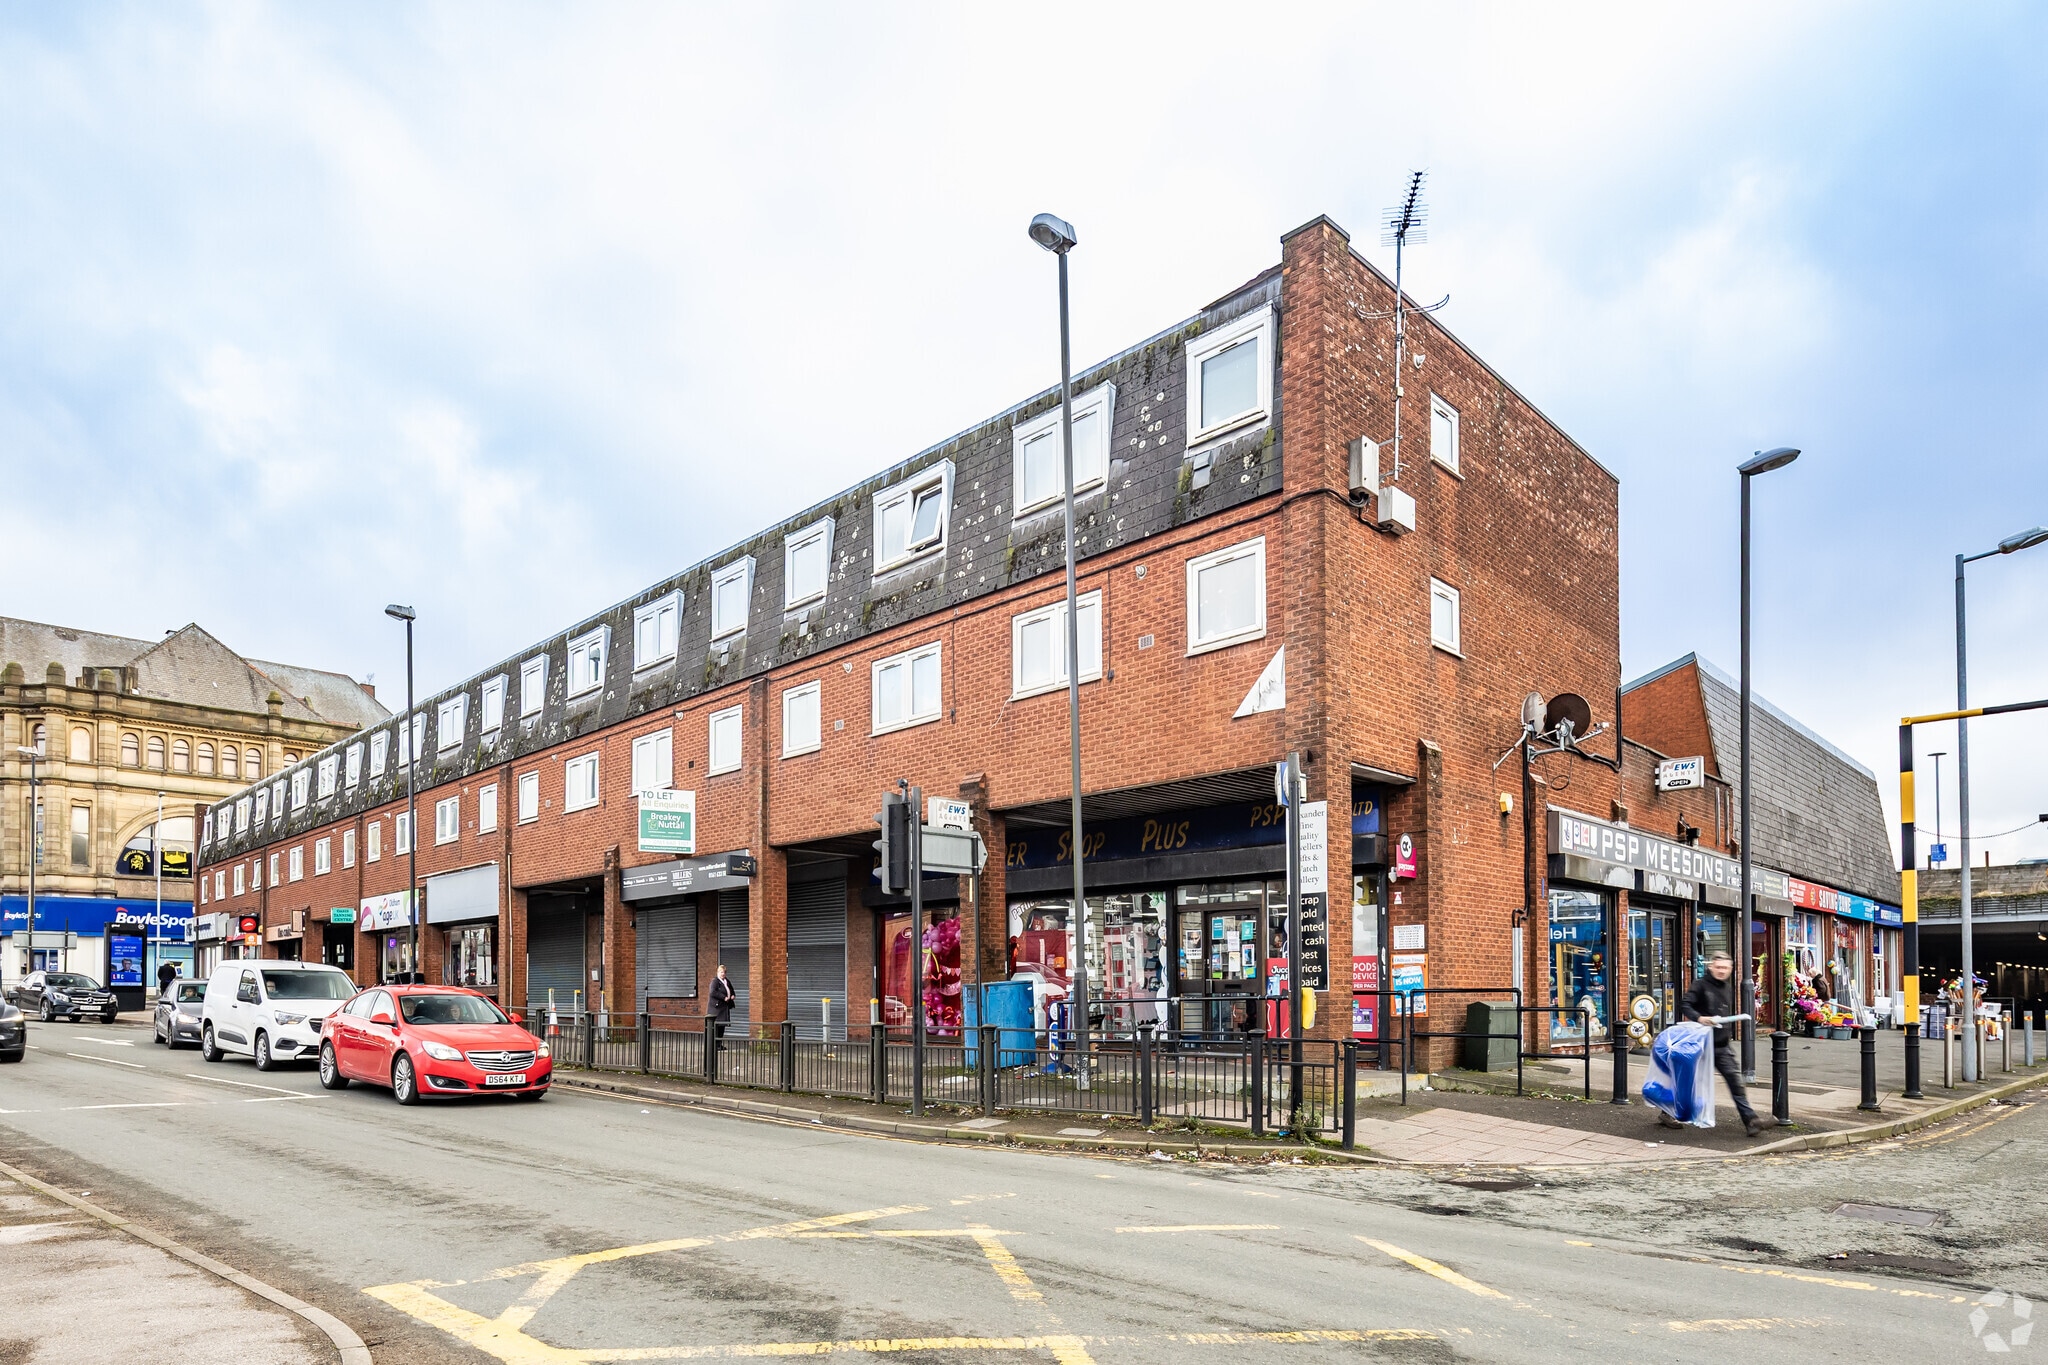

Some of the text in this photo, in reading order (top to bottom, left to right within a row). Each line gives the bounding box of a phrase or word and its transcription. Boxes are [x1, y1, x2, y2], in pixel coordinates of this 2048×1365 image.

[641, 790, 674, 800] TO LET
[653, 800, 690, 809] Enquiries
[651, 812, 682, 822] Breakey
[658, 820, 685, 829] Nuttall
[1141, 819, 1190, 852] PLUS
[1352, 800, 1374, 817] LTD
[1601, 828, 1639, 863] PSP
[1645, 839, 1723, 883] MEESONS
[1301, 865, 1318, 873] atch
[1397, 863, 1415, 872] payzone
[1301, 896, 1319, 906] crap
[1305, 936, 1325, 946] cash
[1302, 965, 1322, 973] rices
[1353, 962, 1377, 972] PODS
[1352, 972, 1377, 980] DEVICE
[1395, 976, 1421, 986] IS NOW
[488, 1075, 524, 1084] DS64 KTJ
